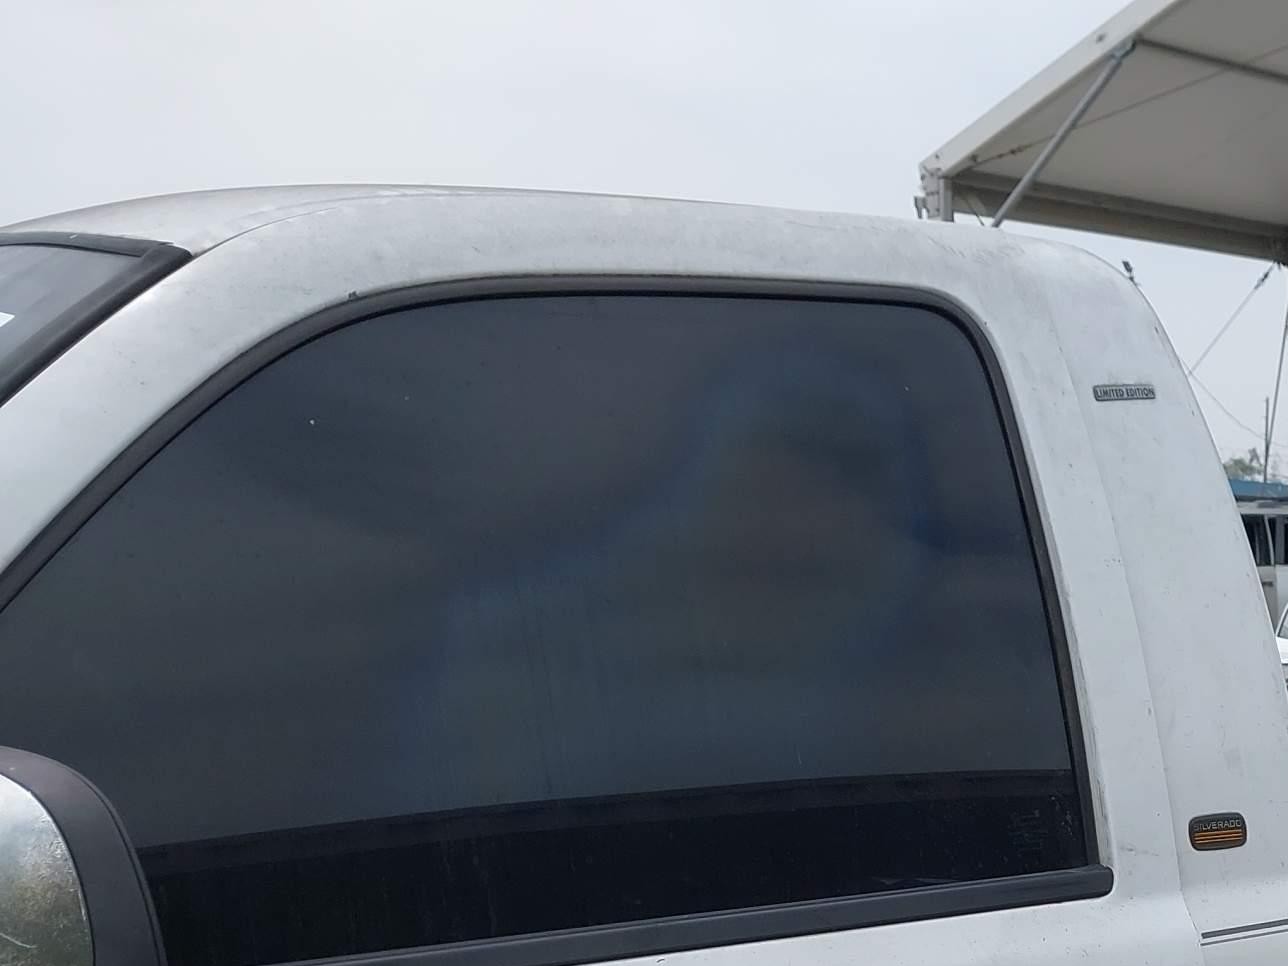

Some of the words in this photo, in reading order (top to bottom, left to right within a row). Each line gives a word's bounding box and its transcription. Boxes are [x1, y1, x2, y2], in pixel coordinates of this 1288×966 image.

[1096, 387, 1124, 398] LIMITED
[1125, 386, 1154, 397] EDITION
[1193, 819, 1242, 831] SILVERADO
